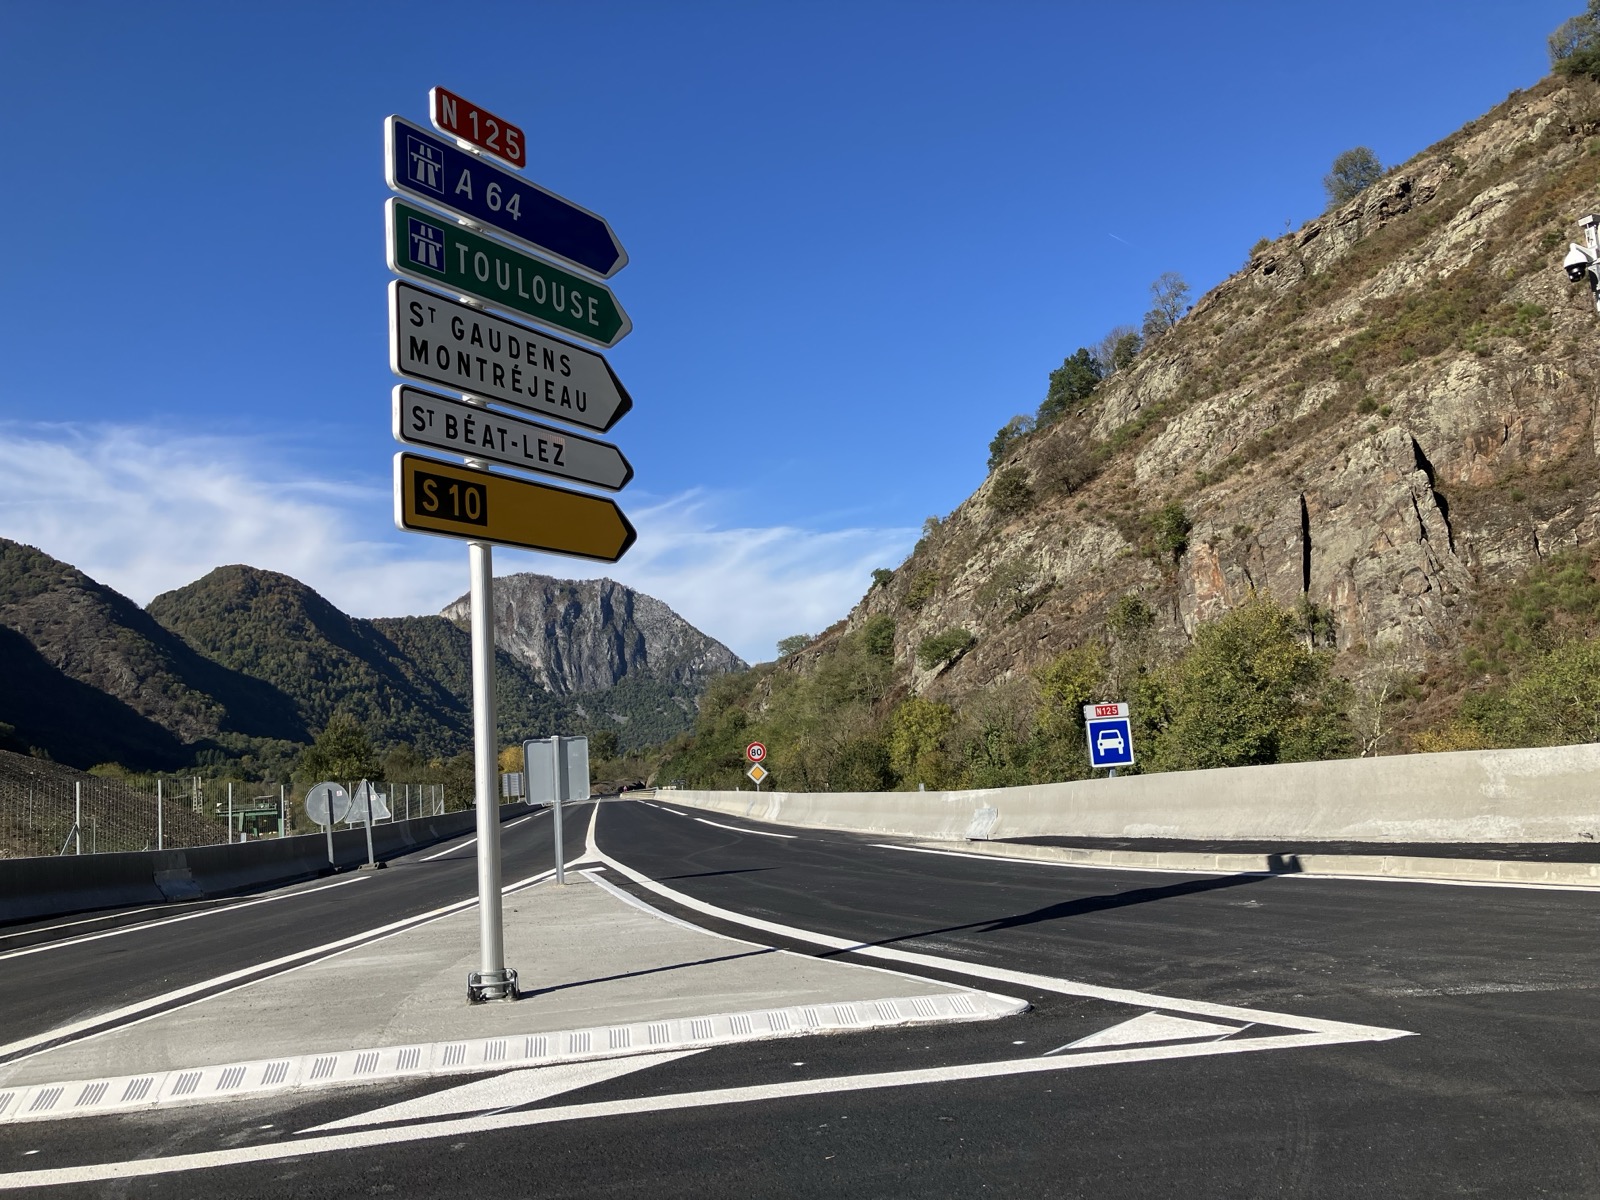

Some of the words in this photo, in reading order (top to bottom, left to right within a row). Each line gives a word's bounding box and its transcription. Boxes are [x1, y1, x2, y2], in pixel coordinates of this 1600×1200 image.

[442, 94, 457, 129] N
[469, 110, 520, 159] 125
[455, 169, 472, 200] A
[486, 182, 521, 221] 64
[455, 242, 599, 326] TOULOUSE
[409, 335, 587, 412] MONTRÉJEAU
[451, 315, 572, 377] GAUDENS
[445, 414, 565, 466] BÉAT-LEZ
[422, 479, 439, 511] S
[449, 484, 481, 519] 10
[751, 748, 762, 756] 80
